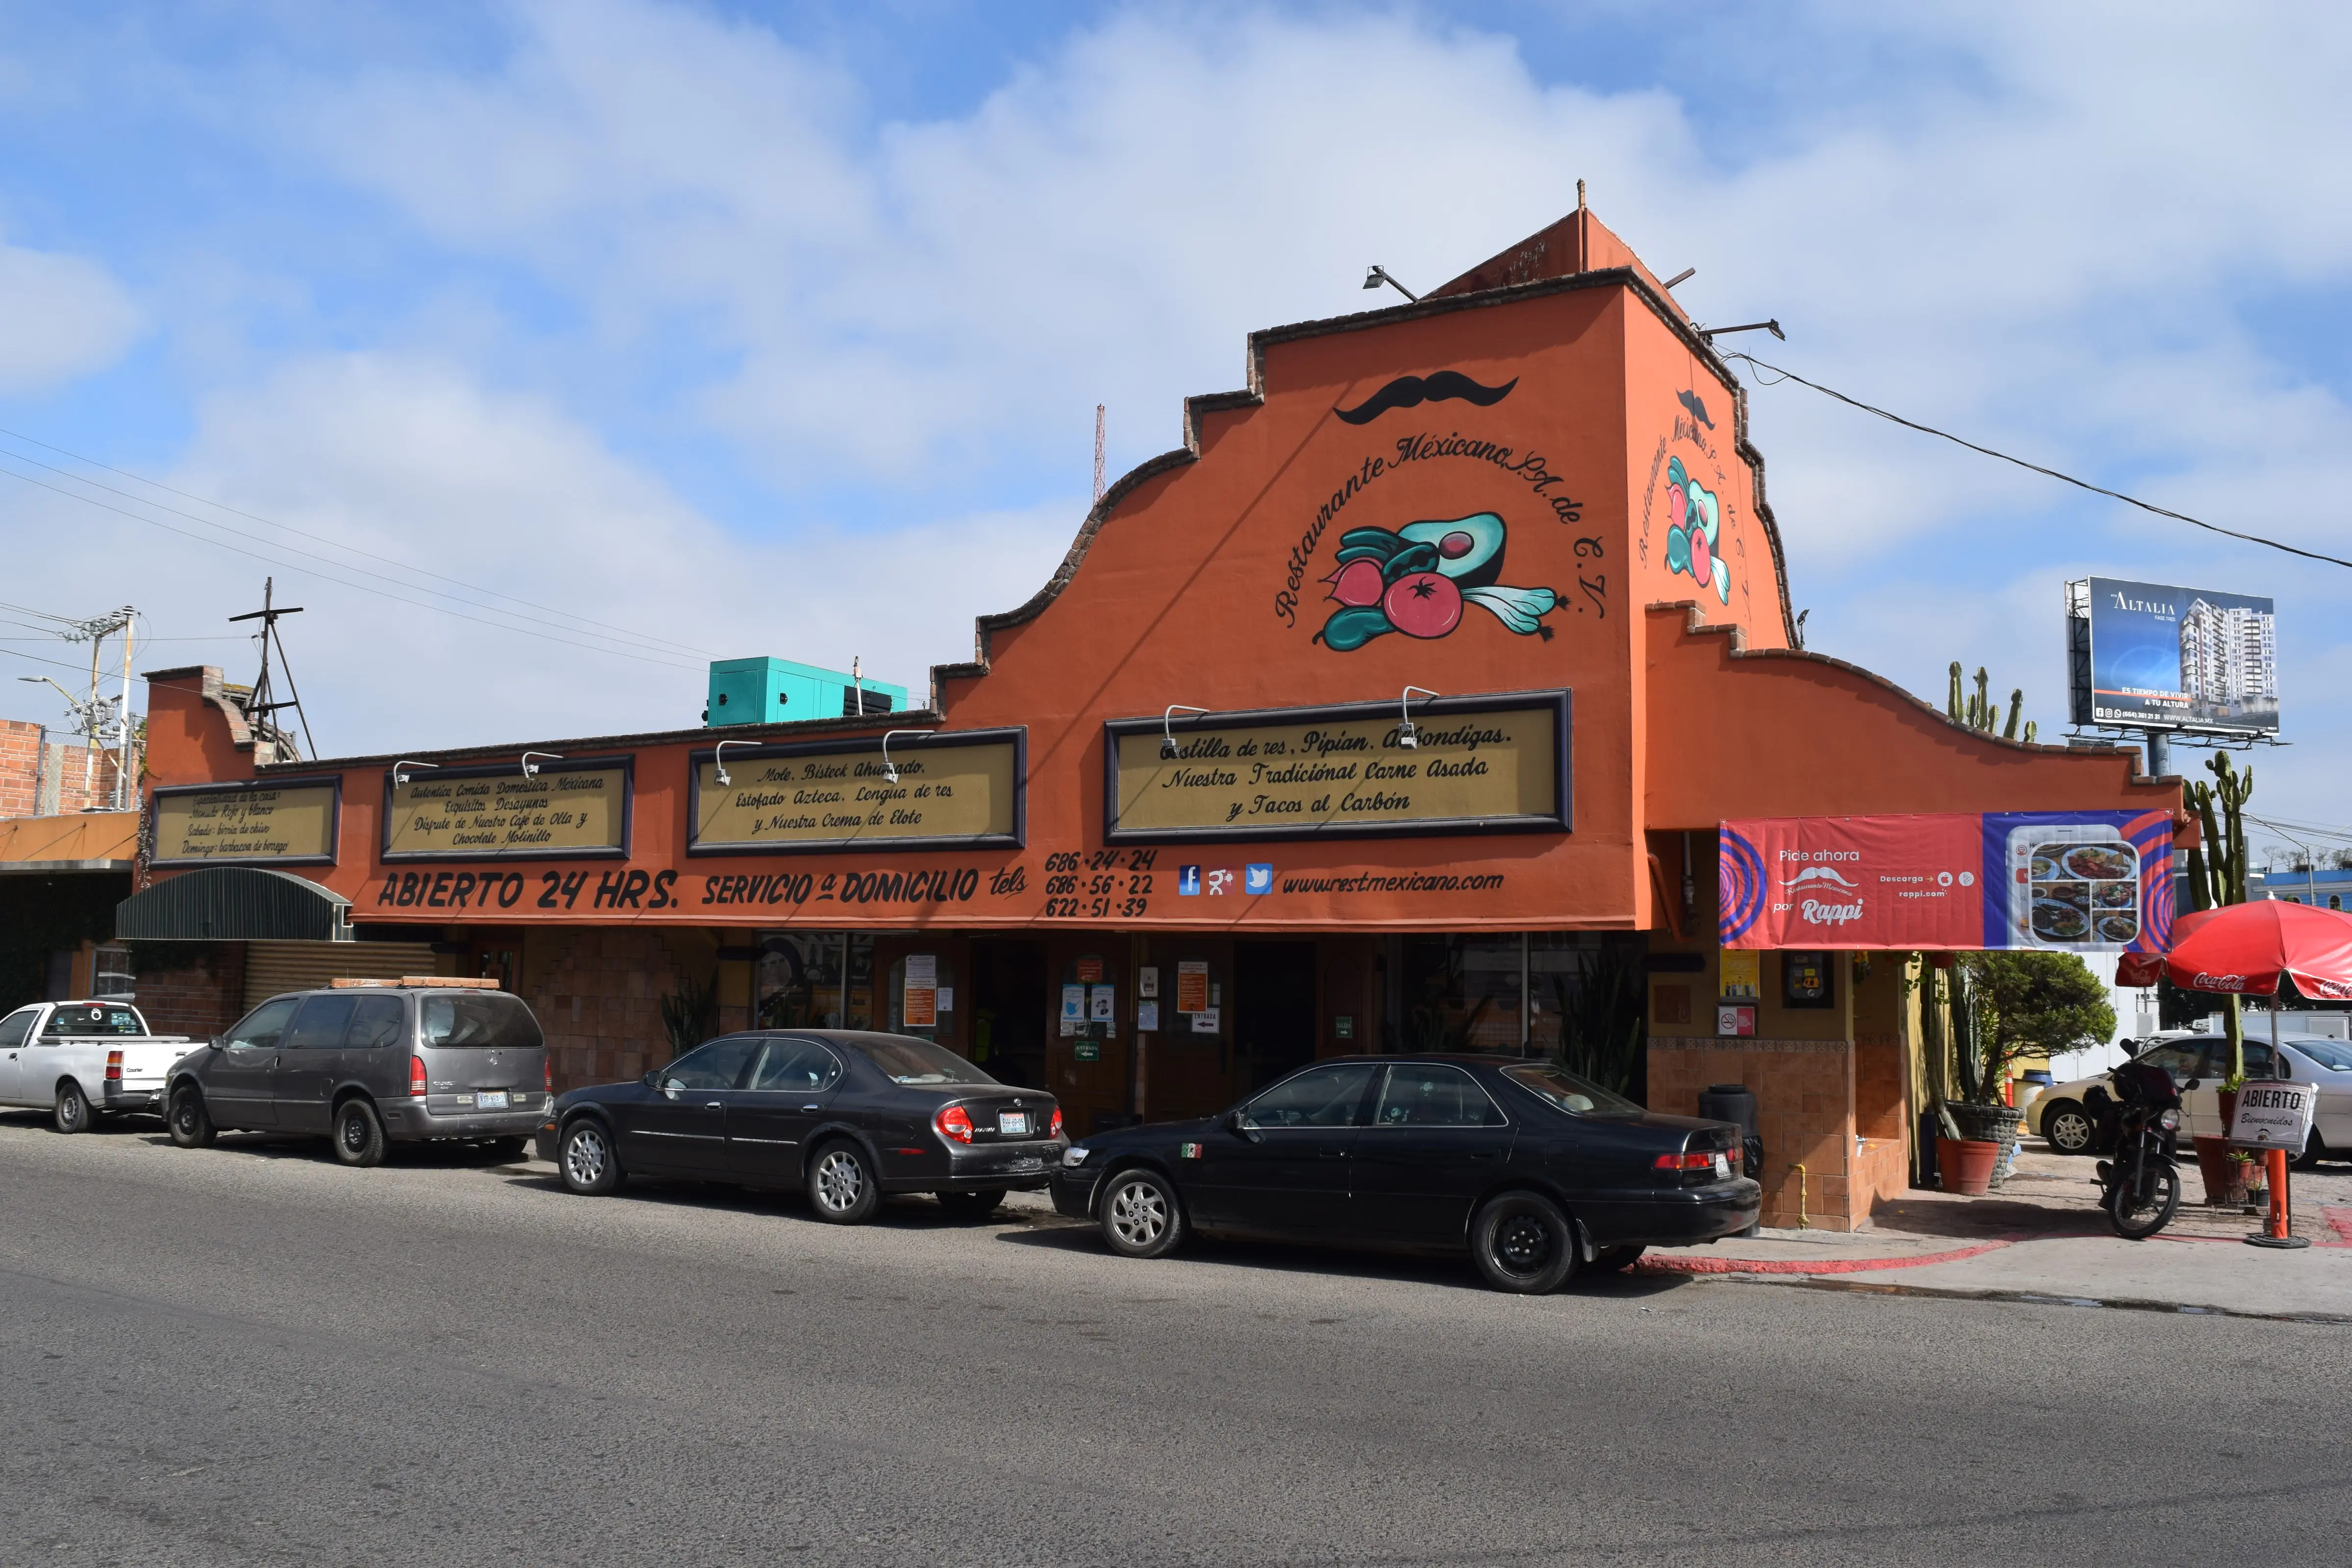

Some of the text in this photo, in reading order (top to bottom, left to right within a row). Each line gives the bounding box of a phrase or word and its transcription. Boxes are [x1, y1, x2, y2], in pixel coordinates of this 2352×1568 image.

[1639, 434, 1667, 570] Restaurante
[1727, 503, 1736, 529] de
[1274, 456, 1384, 629] Restaurante
[1552, 496, 1584, 525] de
[2113, 591, 2176, 615] ALTALIA
[2132, 688, 2158, 696] TIEMPO
[2170, 691, 2189, 700] VIVIR
[2162, 700, 2189, 709] ALTURA
[1237, 738, 1257, 757] de
[801, 763, 848, 780] Bisteck
[854, 760, 925, 778] Ahuado.
[1162, 767, 1237, 788] Nuestra
[1365, 761, 1417, 780] Carne
[1426, 757, 1489, 778] Asada
[239, 793, 247, 803] de
[249, 791, 258, 802] la
[456, 783, 490, 797] Comida
[735, 791, 786, 810] Estofado
[854, 786, 907, 806] Lengua
[914, 784, 931, 799] de
[935, 784, 954, 798] res
[189, 803, 274, 824] Menudo Rojo y blanco
[445, 797, 549, 817] Exquisitos Desayunos
[1225, 791, 1410, 822] y Tacos al Carbón
[217, 822, 237, 835] birria
[240, 822, 249, 834] de
[250, 821, 270, 833] chivo
[414, 816, 450, 836] Disfrute
[455, 817, 466, 829] de
[468, 814, 507, 829] Nuestro
[533, 813, 545, 826] de
[550, 811, 572, 825] Olla
[576, 812, 588, 829] y
[752, 809, 922, 834] y Nuestra Crema de Elote
[220, 839, 252, 853] barbacoa
[254, 839, 262, 851] de
[263, 840, 289, 854] borrego
[453, 829, 552, 845] Chocolate Molinillo
[1779, 849, 1860, 861] Pide ahora
[377, 869, 679, 910] ABIERTO 24 HRS.
[701, 872, 813, 906] SERVICIO
[839, 867, 979, 904] DOMICILIO
[988, 865, 1029, 901] tels
[1282, 872, 1504, 894] www.restmexicano.com
[1784, 882, 1853, 897] Restaurante Mexicano
[1899, 890, 1945, 899] rappi.com
[1773, 899, 1864, 926] por Rappi
[2193, 972, 2248, 990] Coca-Cola
[2241, 1089, 2301, 1110] ABIERTO
[2241, 1113, 2293, 1127] Bienvenidos
